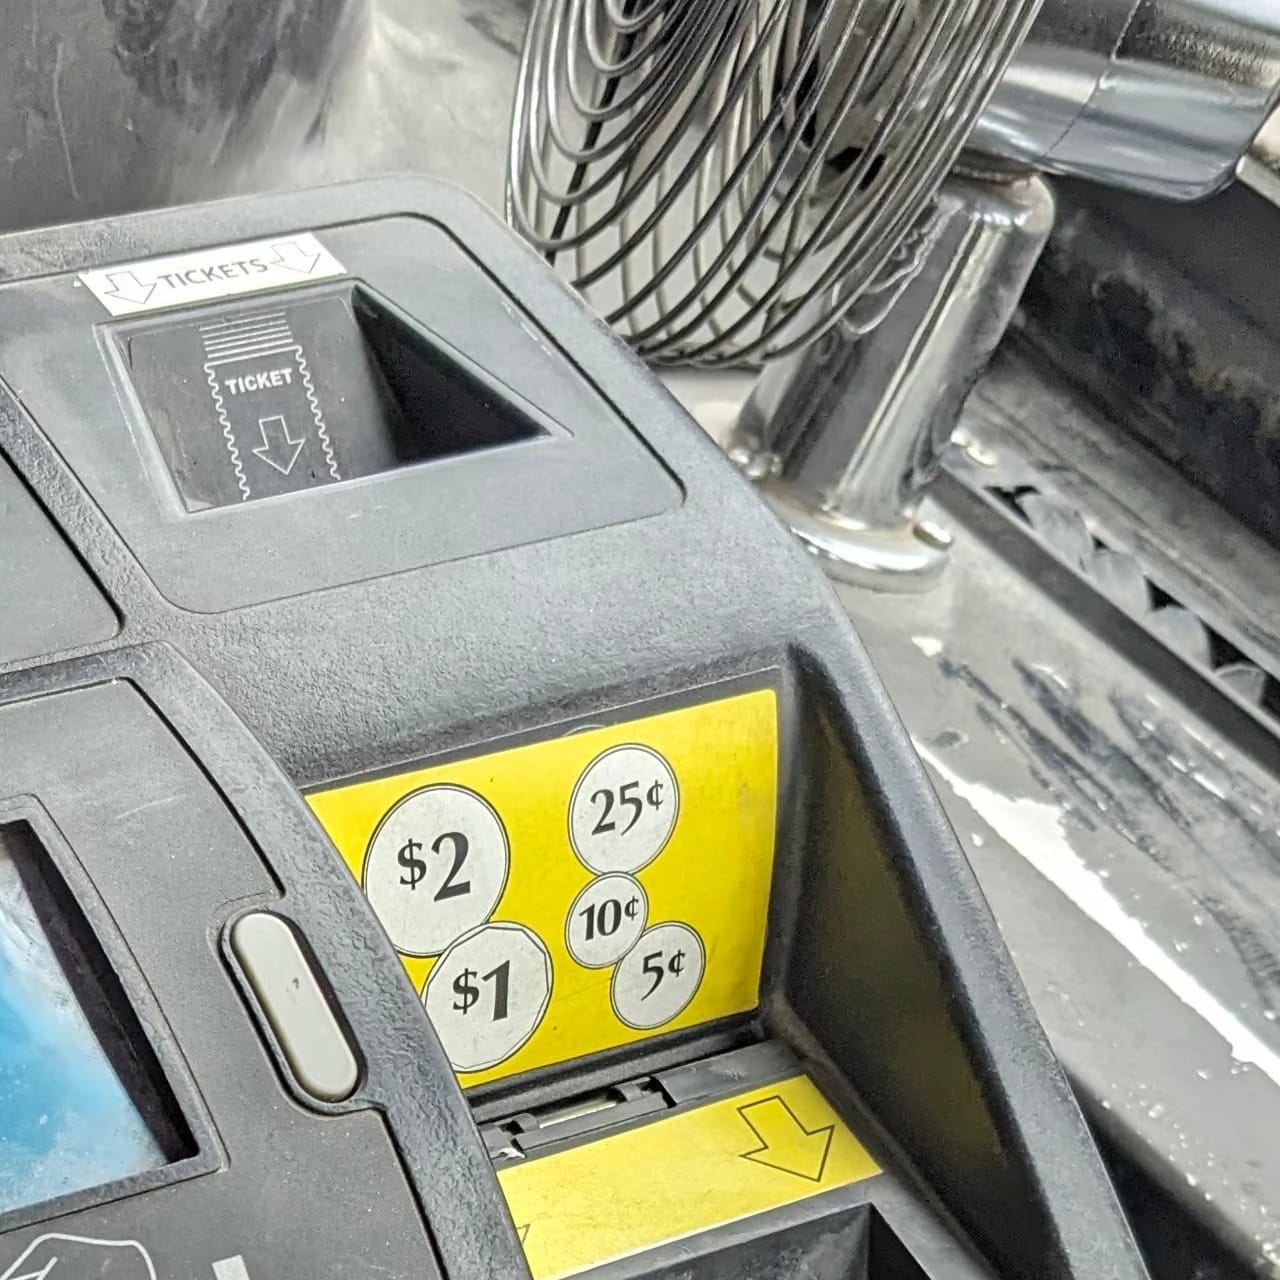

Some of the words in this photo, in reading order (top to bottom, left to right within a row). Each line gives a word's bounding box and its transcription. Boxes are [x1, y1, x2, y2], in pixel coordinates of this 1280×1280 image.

[157, 258, 269, 289] TICKETS
[225, 368, 293, 395] TICKET
[590, 780, 664, 837] 25¢
[397, 831, 471, 902] $2
[578, 896, 640, 941] 10¢
[452, 959, 511, 1021] $1
[641, 950, 686, 1002] 5¢
